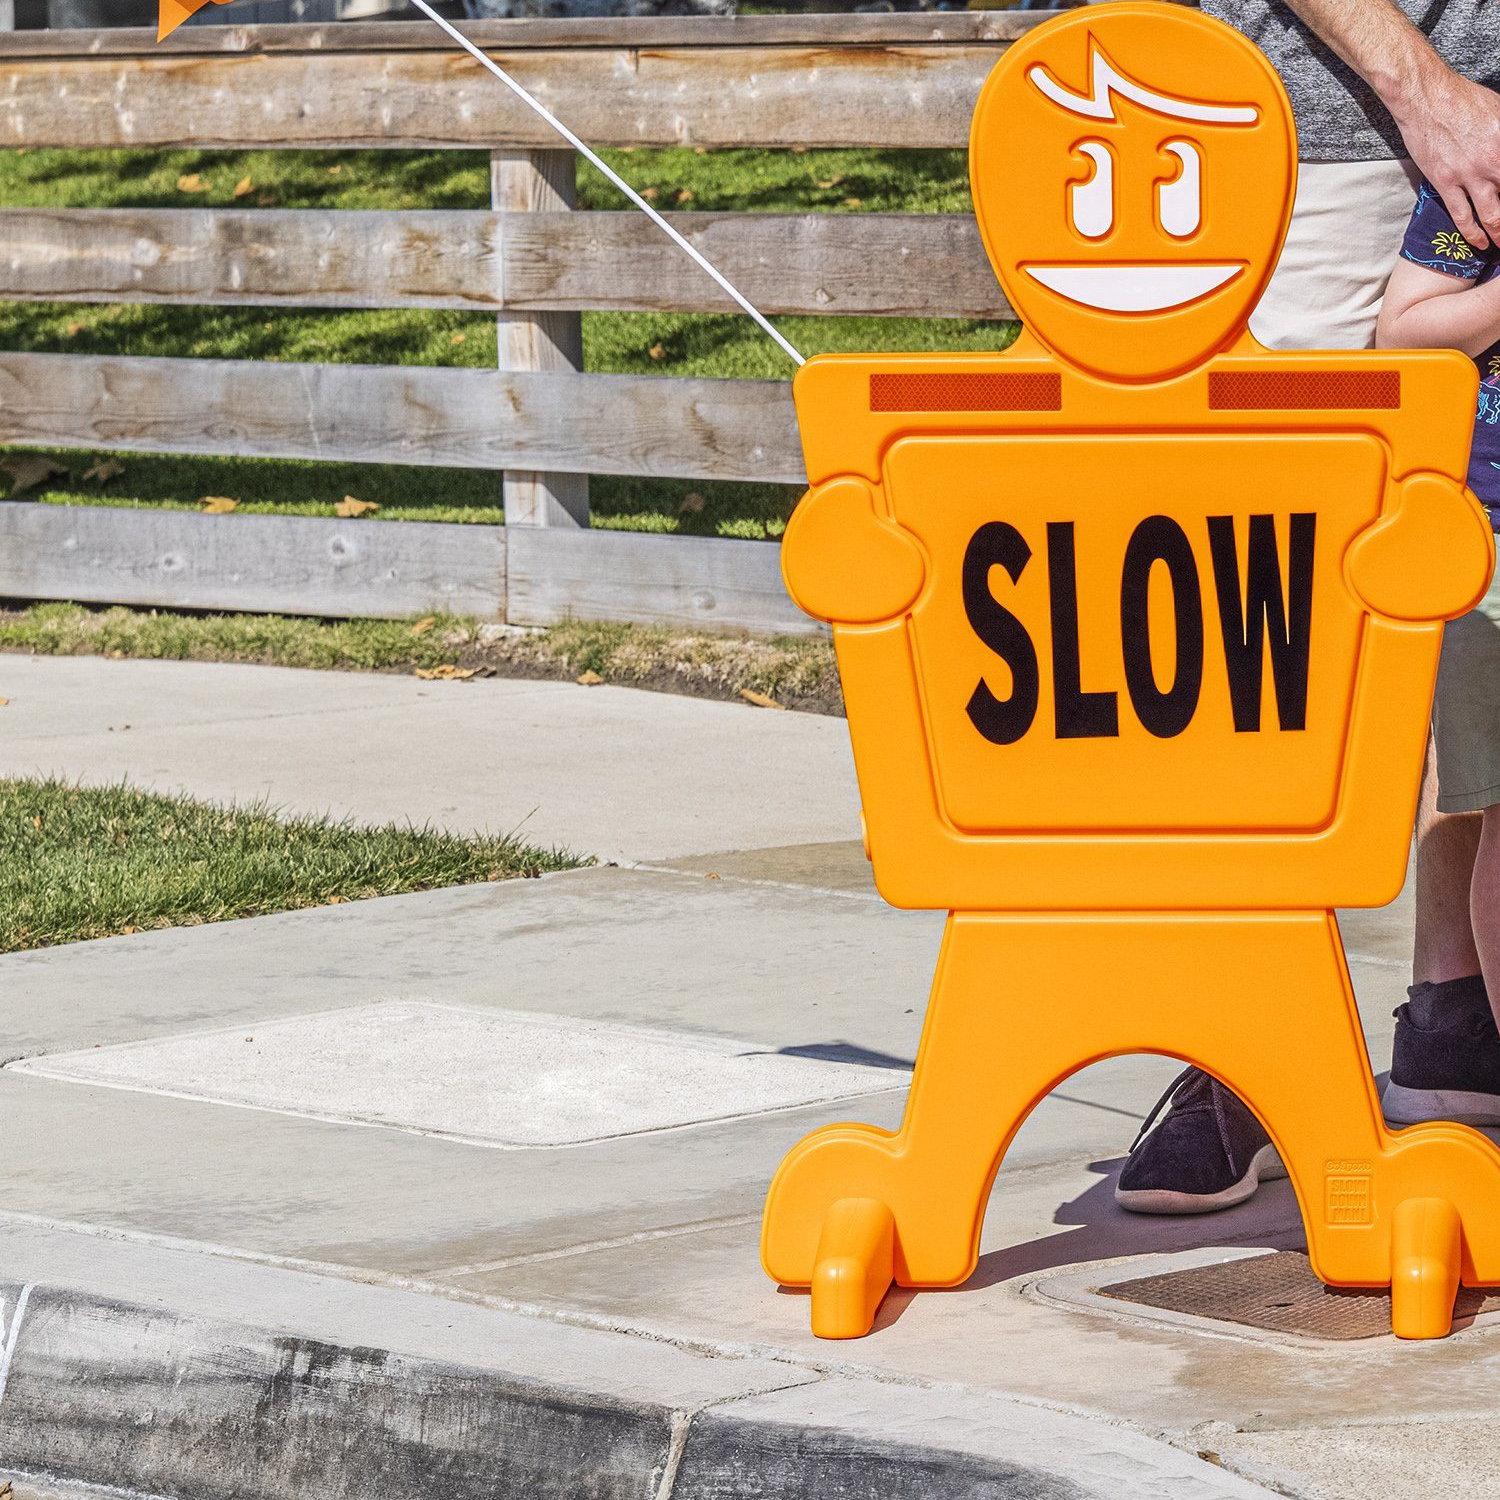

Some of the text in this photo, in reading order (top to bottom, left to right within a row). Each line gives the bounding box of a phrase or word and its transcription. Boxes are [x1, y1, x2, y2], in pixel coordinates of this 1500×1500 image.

[962, 512, 1317, 745] SLOW
[1326, 1160, 1372, 1173] GoSports
[1331, 1179, 1367, 1193] SLOW
[1329, 1194, 1368, 1208] DOWN
